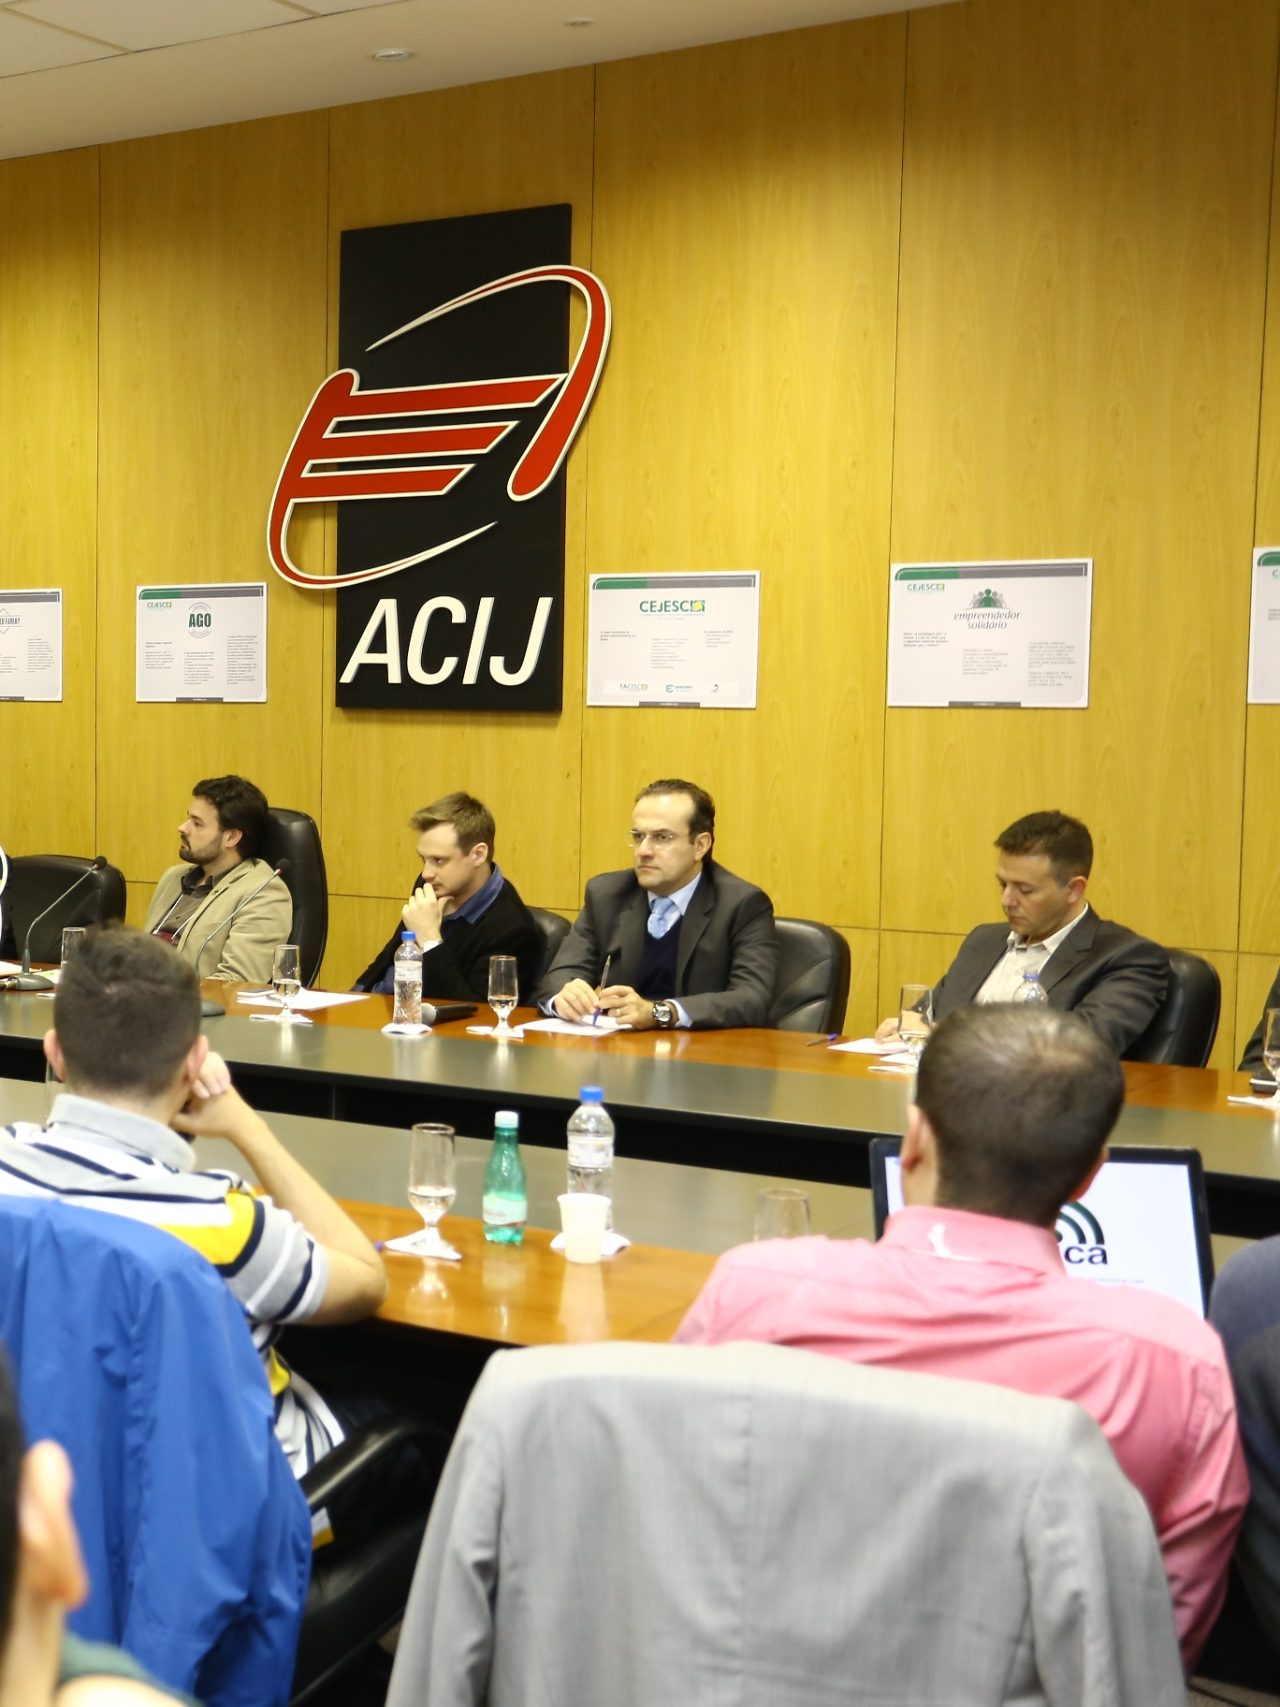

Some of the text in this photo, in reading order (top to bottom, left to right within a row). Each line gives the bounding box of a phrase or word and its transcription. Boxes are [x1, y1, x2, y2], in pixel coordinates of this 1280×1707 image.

[639, 600, 690, 613] CEJESC
[188, 612, 212, 628] AGO
[953, 610, 1020, 622] empreendedor
[339, 595, 553, 686] ACIJ
